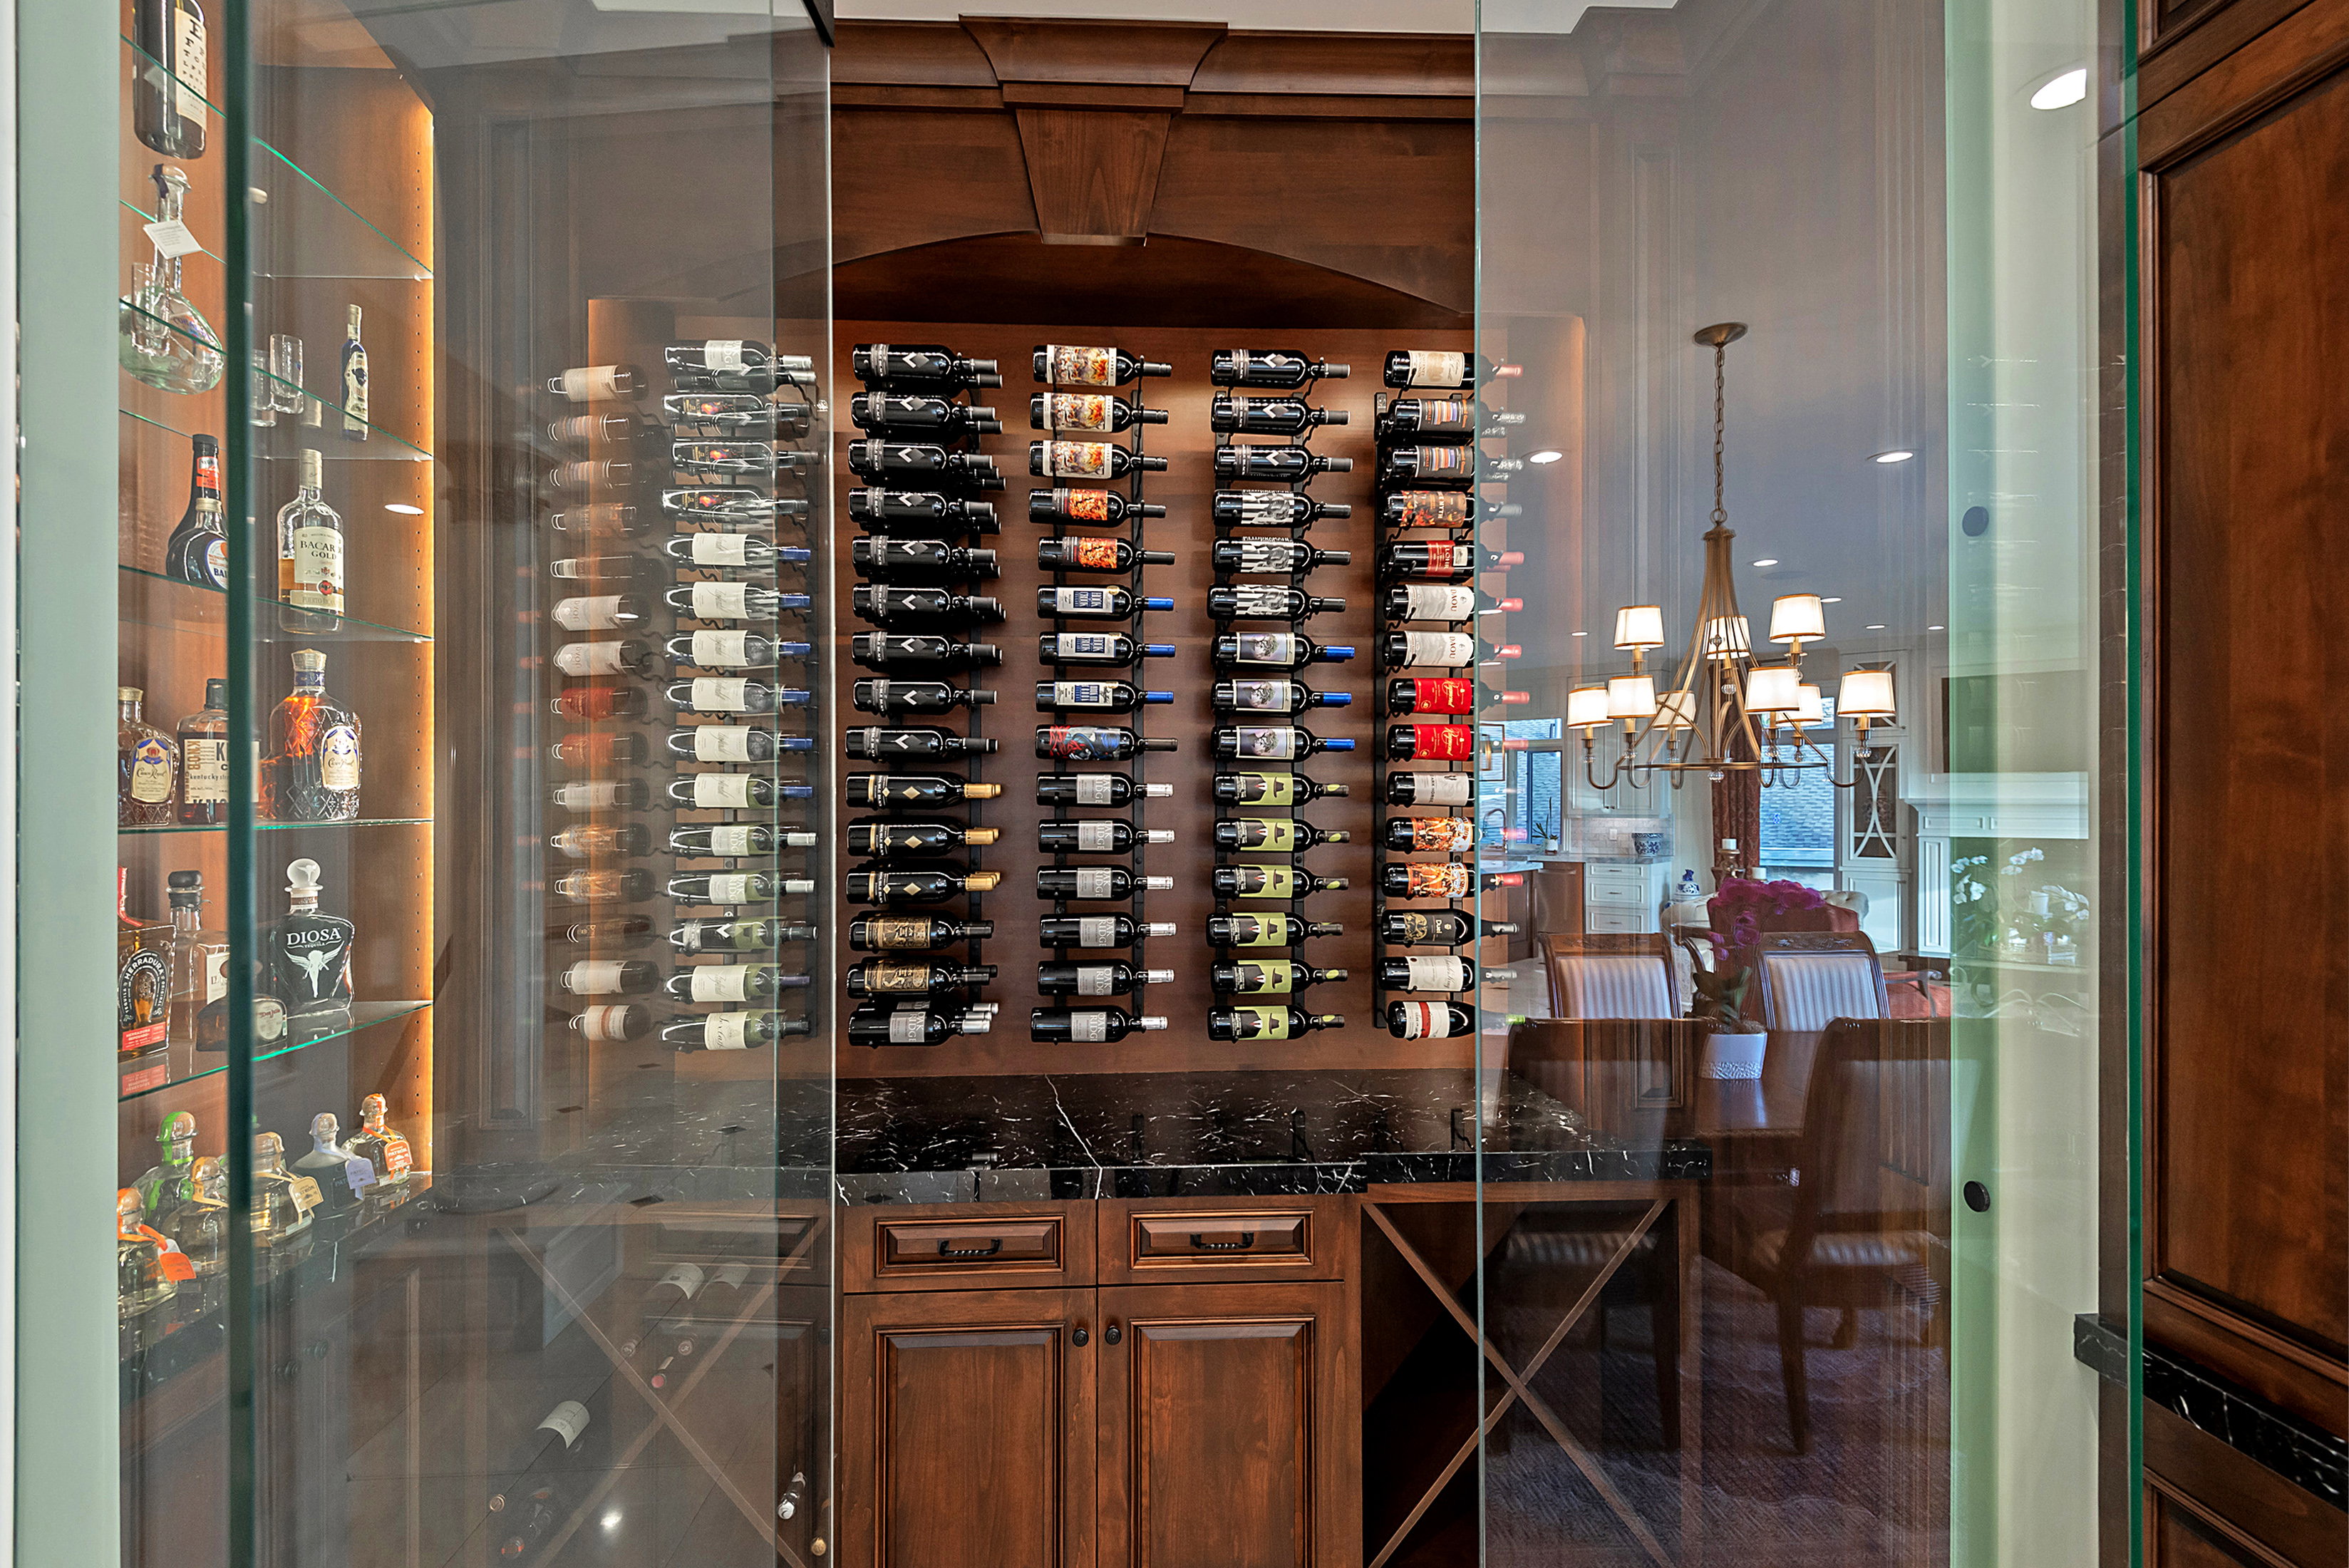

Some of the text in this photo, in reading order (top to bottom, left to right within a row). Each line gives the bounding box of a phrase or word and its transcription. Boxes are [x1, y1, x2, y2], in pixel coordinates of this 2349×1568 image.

[311, 551, 336, 560] GOLD
[187, 741, 200, 770] KNOB
[1095, 775, 1103, 804] RIDGE
[730, 827, 740, 857] RIDGE
[730, 877, 738, 904] RIDGE
[1095, 870, 1103, 898] RIDGE
[286, 929, 342, 946] DIOSA
[1098, 919, 1107, 947] RIDGE
[1106, 917, 1115, 937] OAK
[124, 956, 164, 980] HERRADURA
[1104, 968, 1112, 989] OAK
[908, 1013, 917, 1043] RIDGE
[1097, 1012, 1105, 1033] OAK
